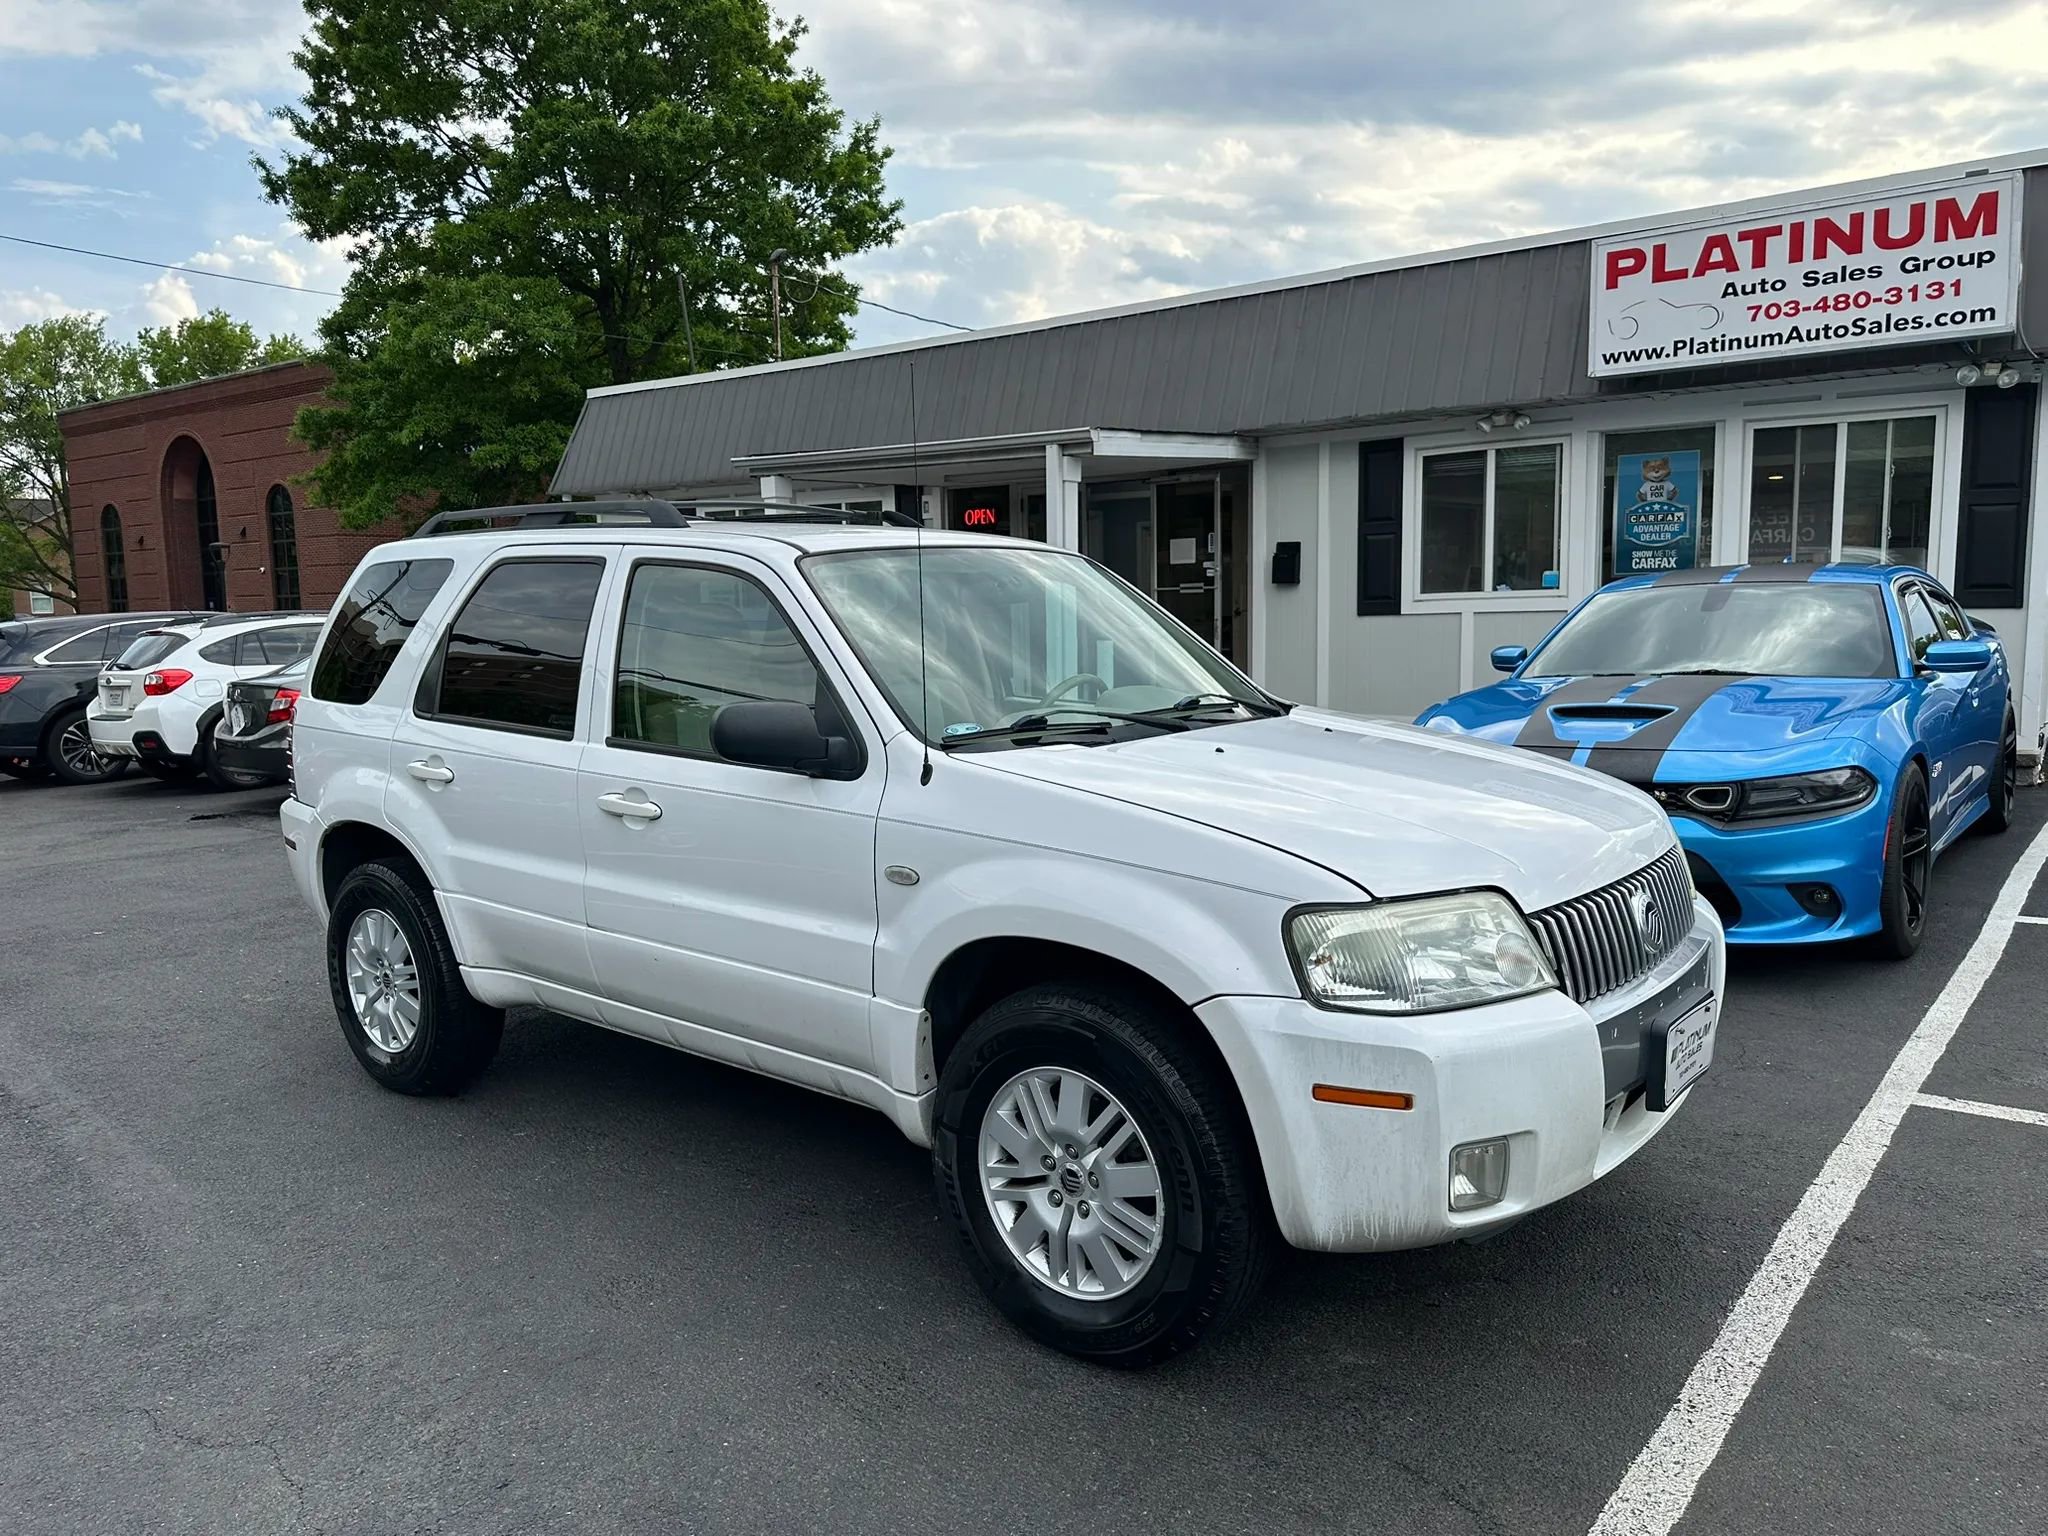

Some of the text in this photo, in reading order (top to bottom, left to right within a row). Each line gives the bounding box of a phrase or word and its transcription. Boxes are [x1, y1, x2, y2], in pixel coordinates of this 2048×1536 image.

[1606, 190, 1999, 290] PLATINUM
[1721, 249, 1996, 299] Auto Sales Group
[1747, 279, 1962, 323] 703-480-3131
[1602, 306, 1996, 365] www.PlatinumAutoSales.com
[965, 508, 995, 525] OPEN
[1630, 512, 1684, 523] CARFAX
[1633, 524, 1680, 533] ADVANTAGE
[1640, 533, 1671, 541] DEALER
[1632, 549, 1677, 558] SHOW ME THE
[1632, 557, 1677, 569] CARFAX
